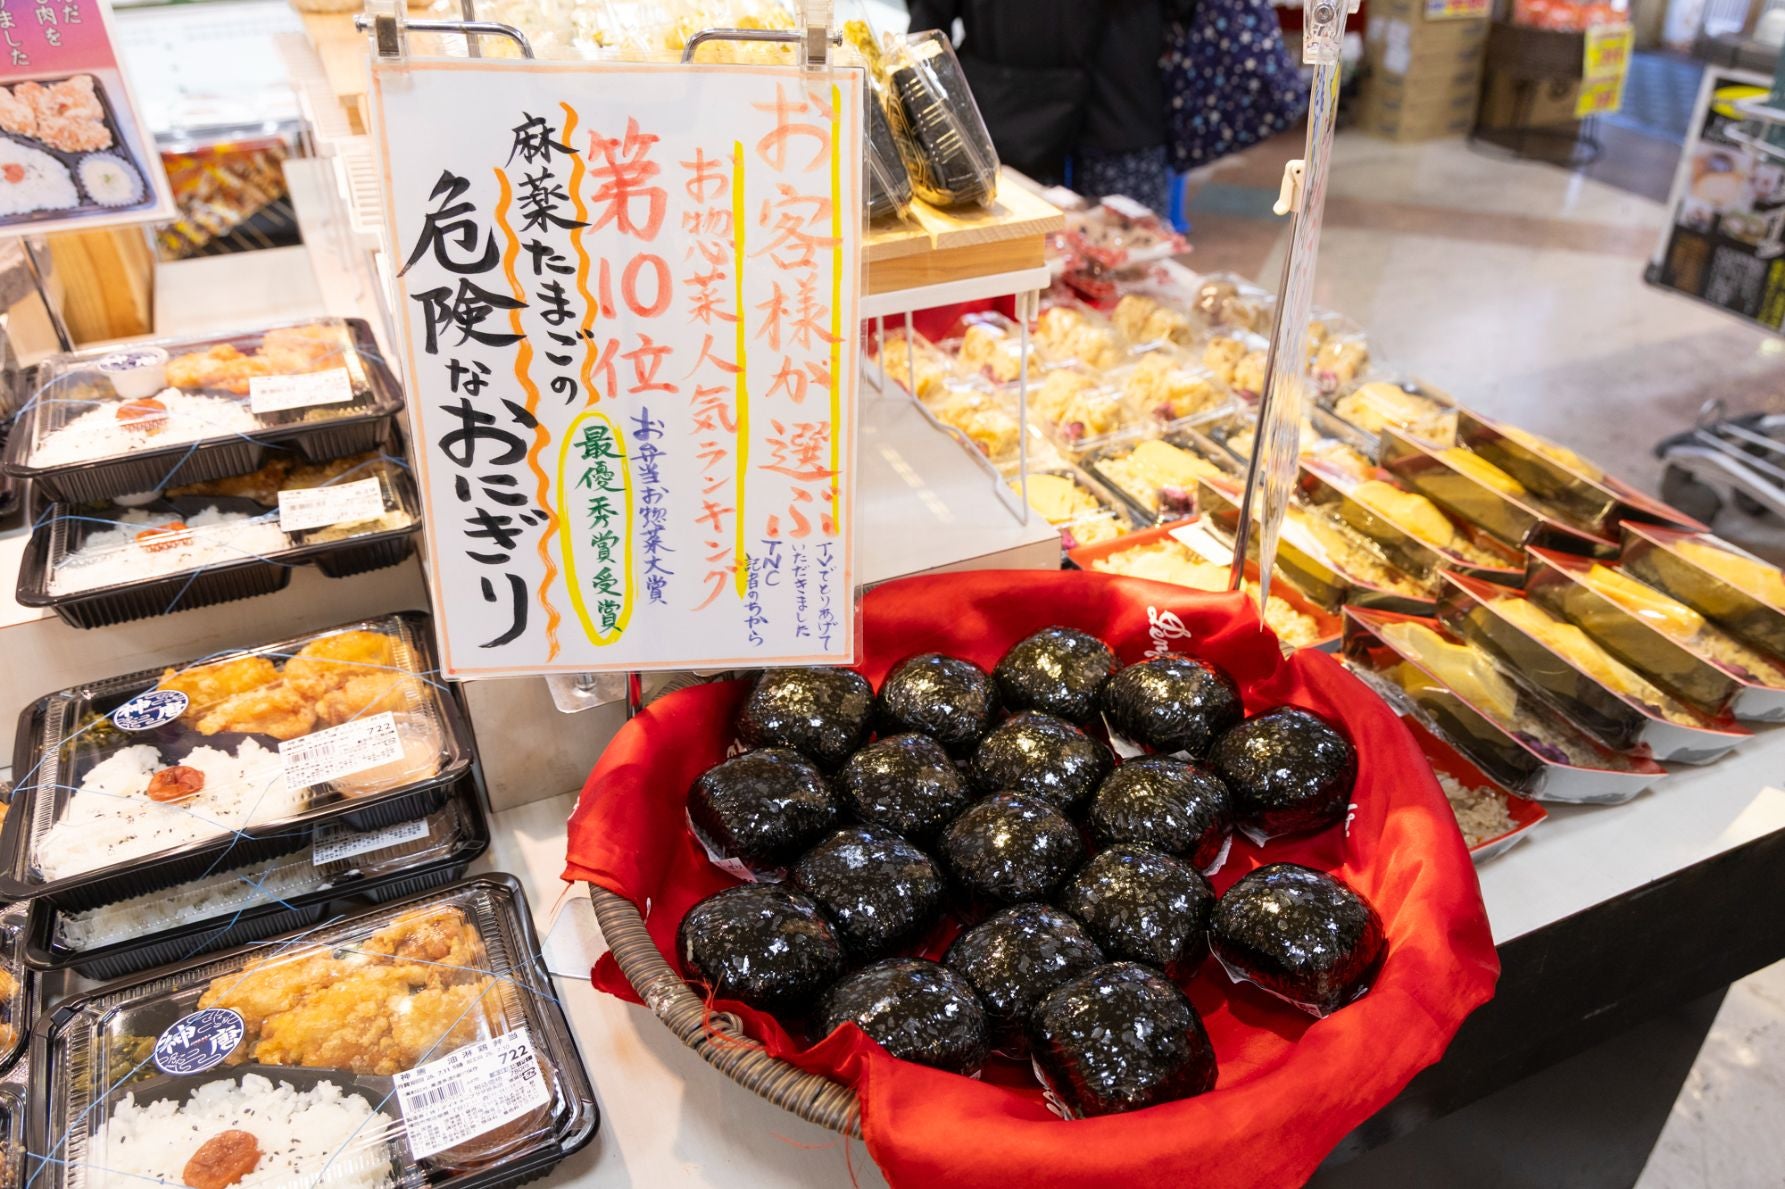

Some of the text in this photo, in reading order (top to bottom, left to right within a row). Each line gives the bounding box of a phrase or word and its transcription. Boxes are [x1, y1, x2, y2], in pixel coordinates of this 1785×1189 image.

[505, 110, 593, 404] 麻薬たまごの
[586, 116, 679, 398] 第10位
[747, 81, 845, 538] お客様が選ぶ
[396, 169, 549, 649] 危険なおにぎり
[678, 147, 744, 612] お惣菜人気ランキング
[573, 425, 627, 635] 最優秀賞受賞
[630, 405, 676, 605] お弁当お惣菜大賞
[744, 552, 768, 647] 記者のちから
[761, 540, 783, 586] TNC
[791, 544, 811, 638] いただきました
[816, 542, 838, 651] TVでとりあげて
[368, 722, 391, 735] 722
[497, 1044, 528, 1065] 722
